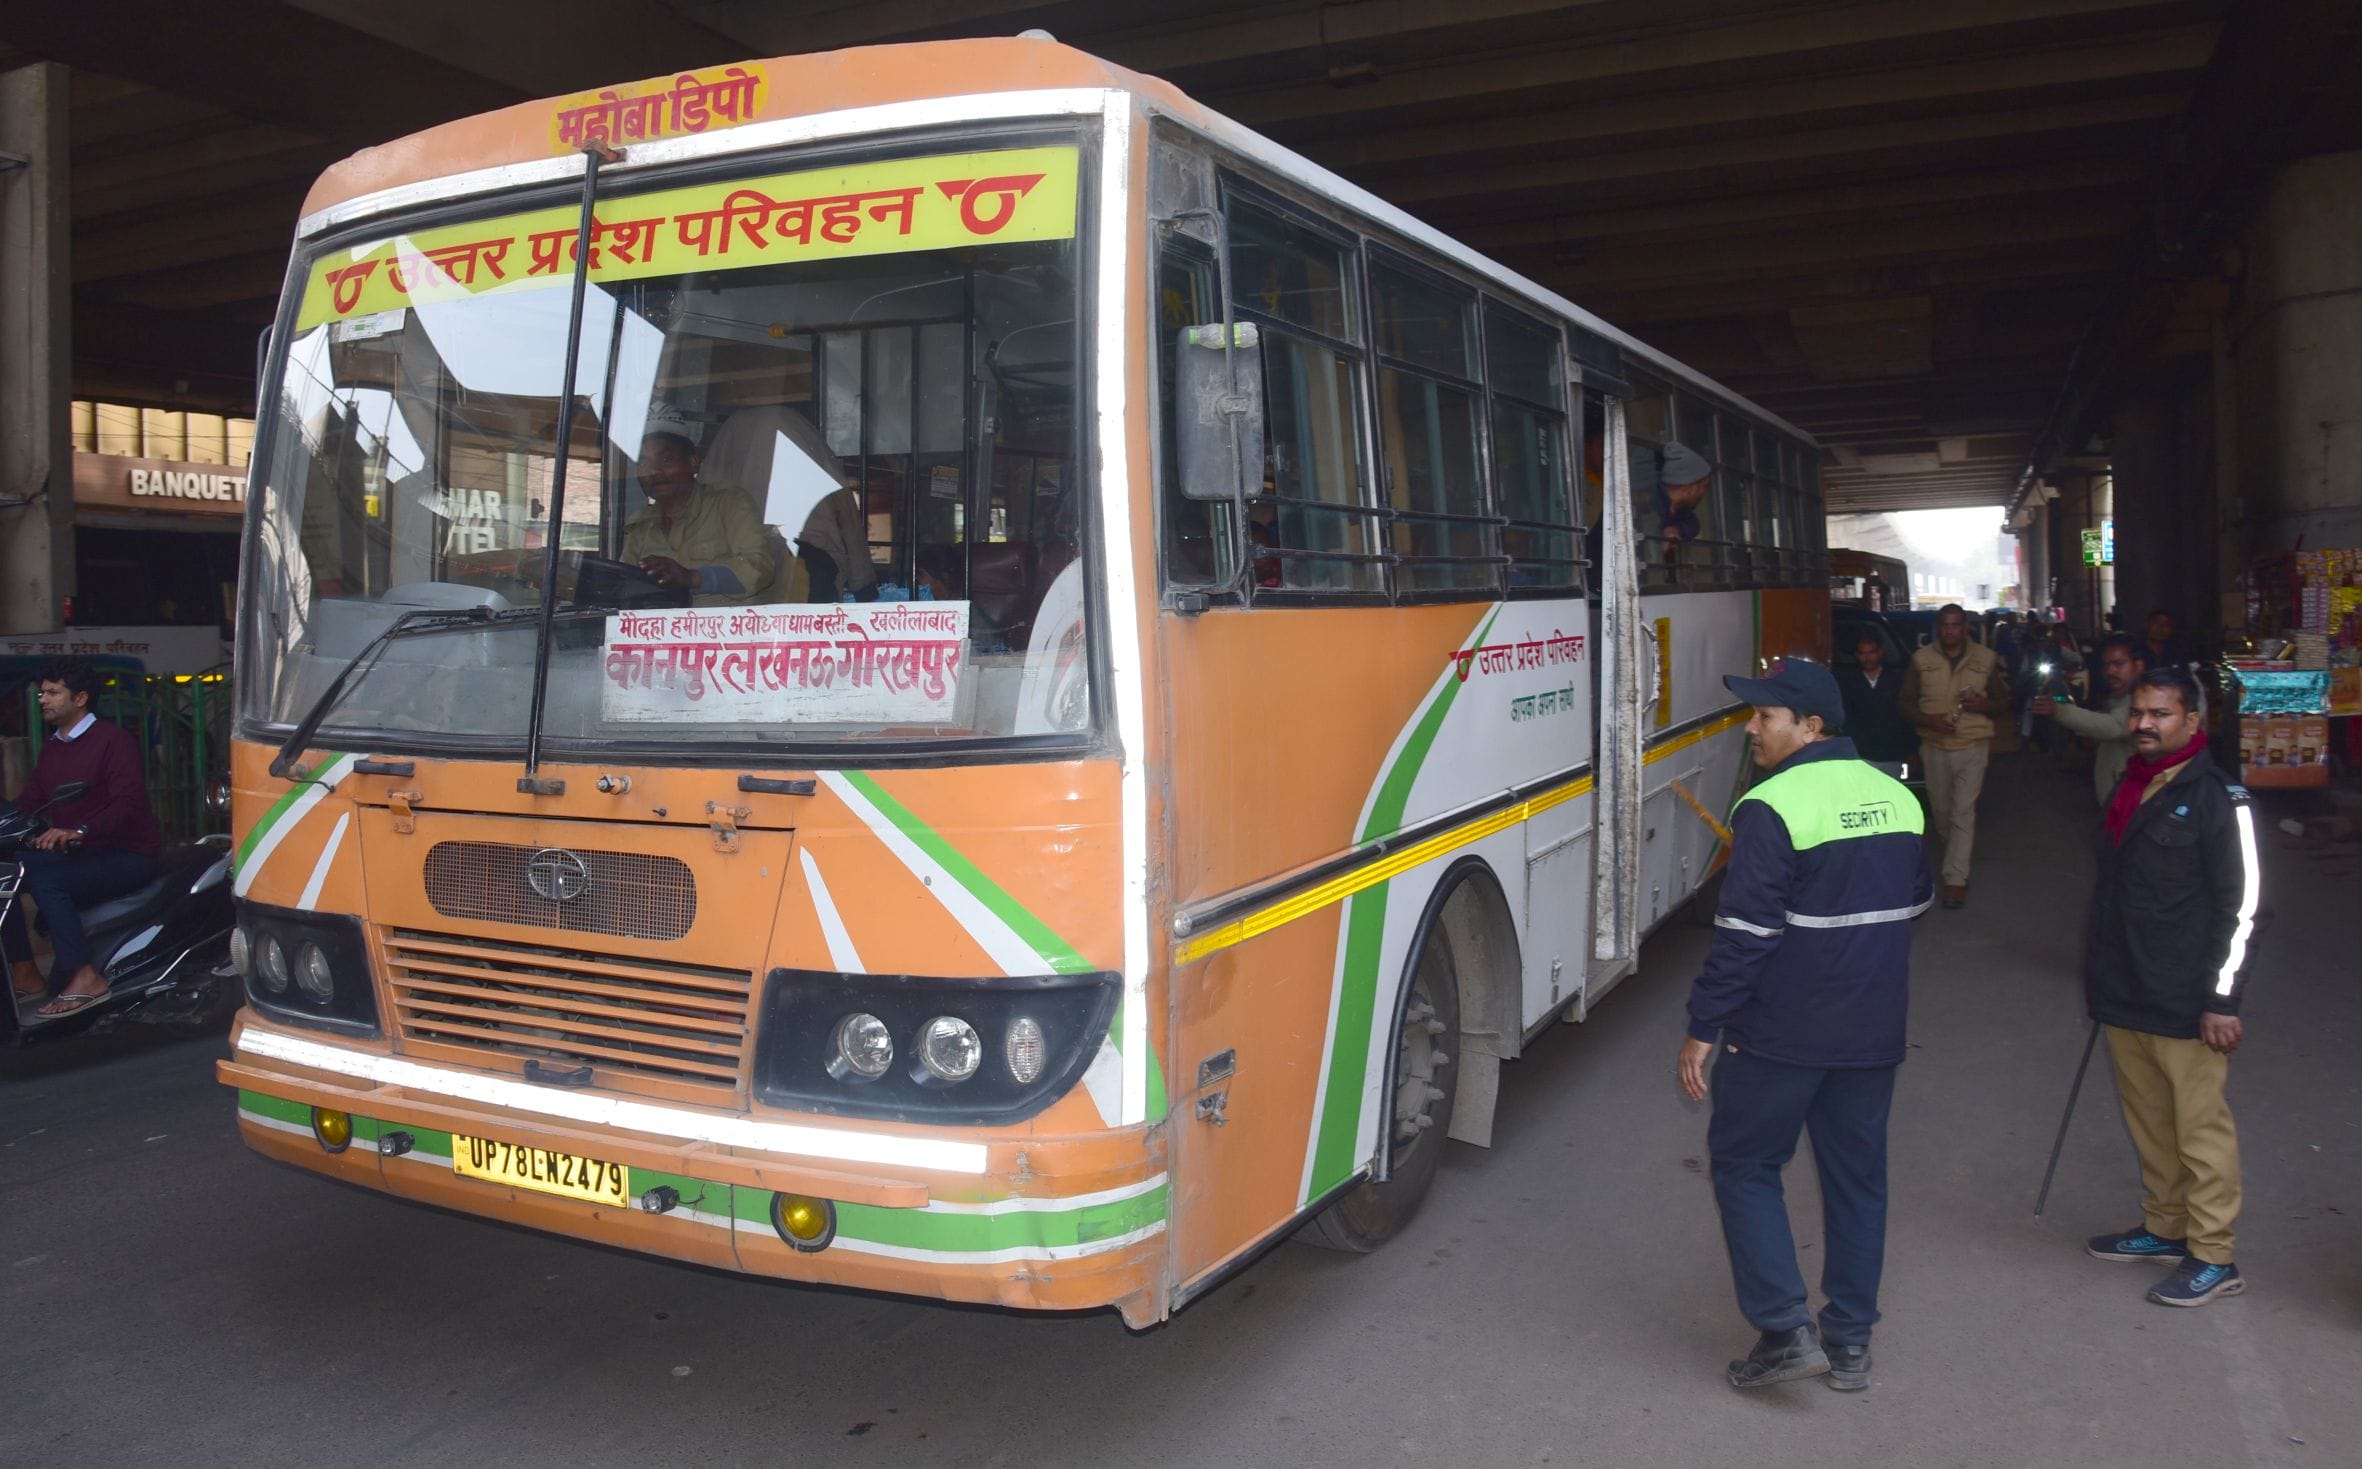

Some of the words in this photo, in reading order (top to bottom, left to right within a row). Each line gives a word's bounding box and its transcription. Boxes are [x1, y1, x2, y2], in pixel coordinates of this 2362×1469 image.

[557, 90, 668, 148] महोबा
[667, 68, 760, 133] डिपो
[384, 237, 515, 293] उत्तर
[527, 214, 666, 276] प्रदेश
[673, 187, 924, 256] परिवहन
[130, 468, 246, 501] BANQUET
[671, 610, 725, 639] हमीरपुर
[870, 604, 959, 635] खलीलाबाद
[1478, 644, 1514, 675] उत्तर
[1516, 631, 1544, 670] प्रदेश
[1547, 629, 1584, 665] परिवहन
[606, 643, 723, 701] कानपुर
[721, 641, 832, 694] लखनऊ
[835, 623, 961, 701] गोरखपुर
